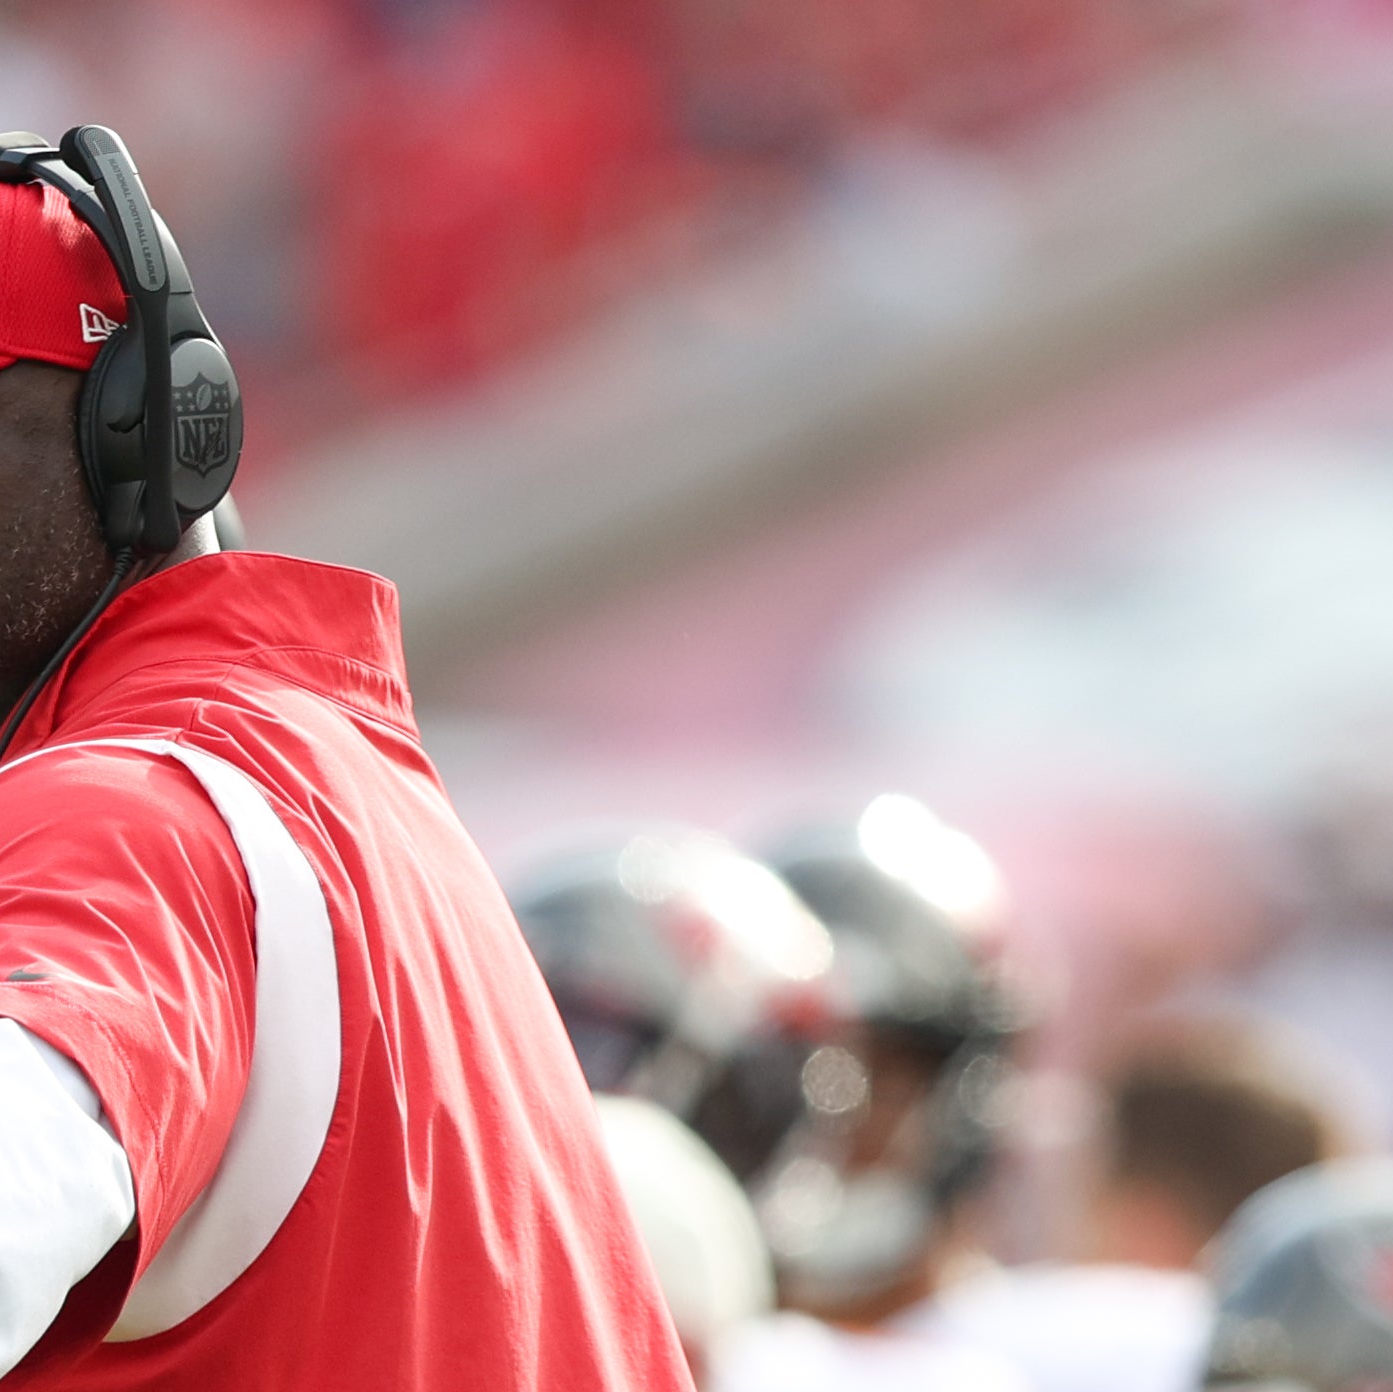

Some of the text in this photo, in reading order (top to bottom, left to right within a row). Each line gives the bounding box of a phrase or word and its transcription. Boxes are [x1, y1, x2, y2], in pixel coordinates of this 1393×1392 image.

[107, 158, 157, 285] NATIONAL FOOTBALL LEAGUE
[178, 416, 228, 463] NFL
